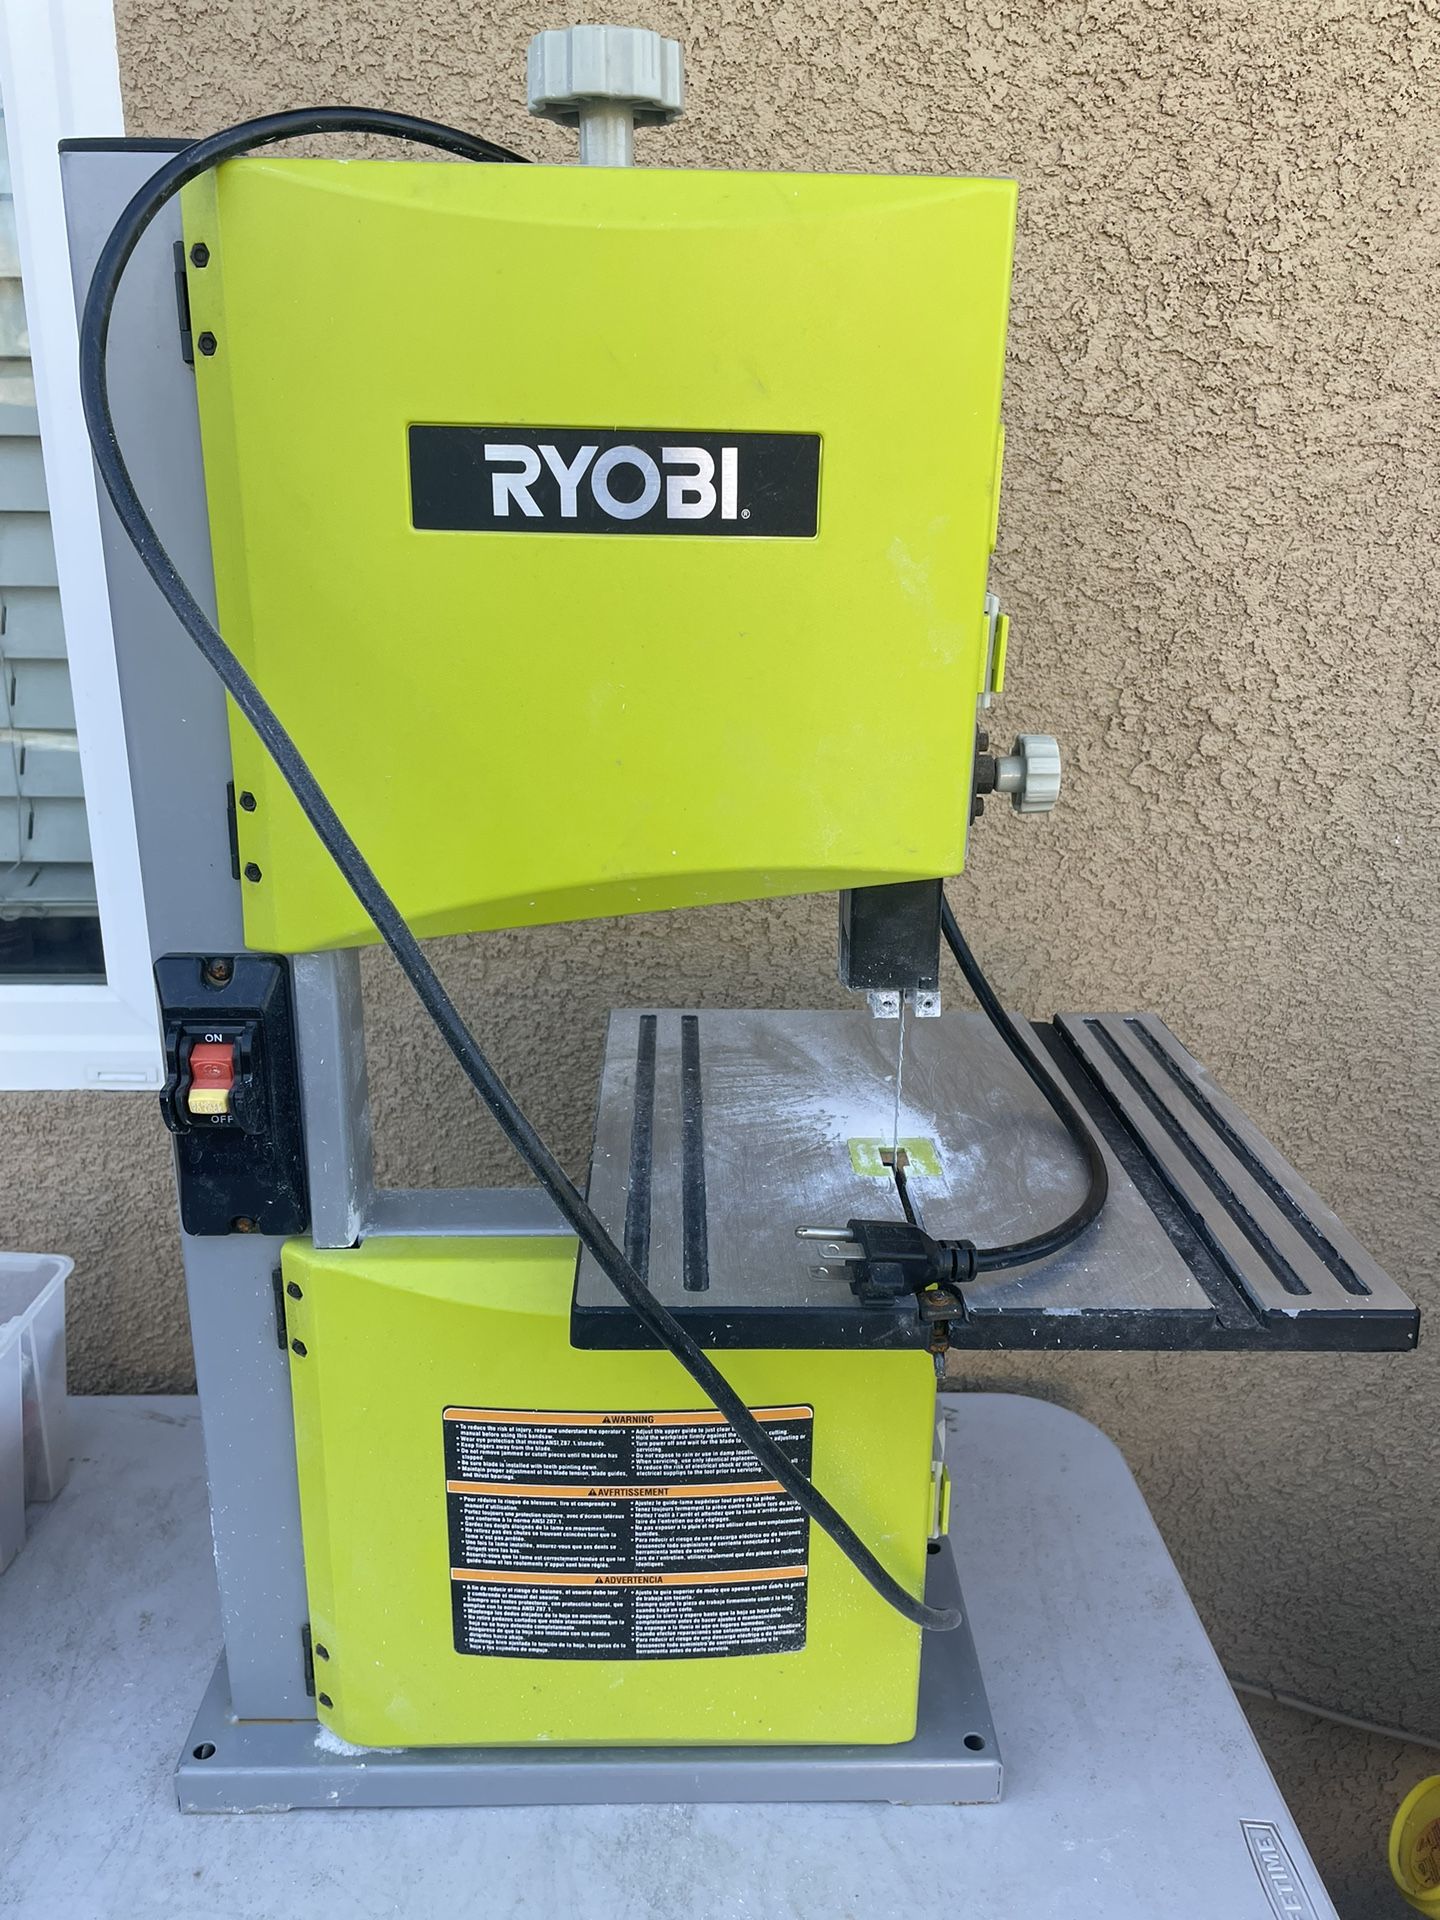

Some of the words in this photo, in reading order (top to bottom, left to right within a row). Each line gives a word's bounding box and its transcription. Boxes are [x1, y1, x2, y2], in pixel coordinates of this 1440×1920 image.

[483, 443, 739, 520] RYOBI
[204, 1033, 223, 1043] ON
[210, 1115, 234, 1124] OFF
[611, 1415, 654, 1424] WARNING
[598, 1488, 669, 1496] AVERTISSEMENT
[604, 1576, 663, 1584] ADVERTENCIA
